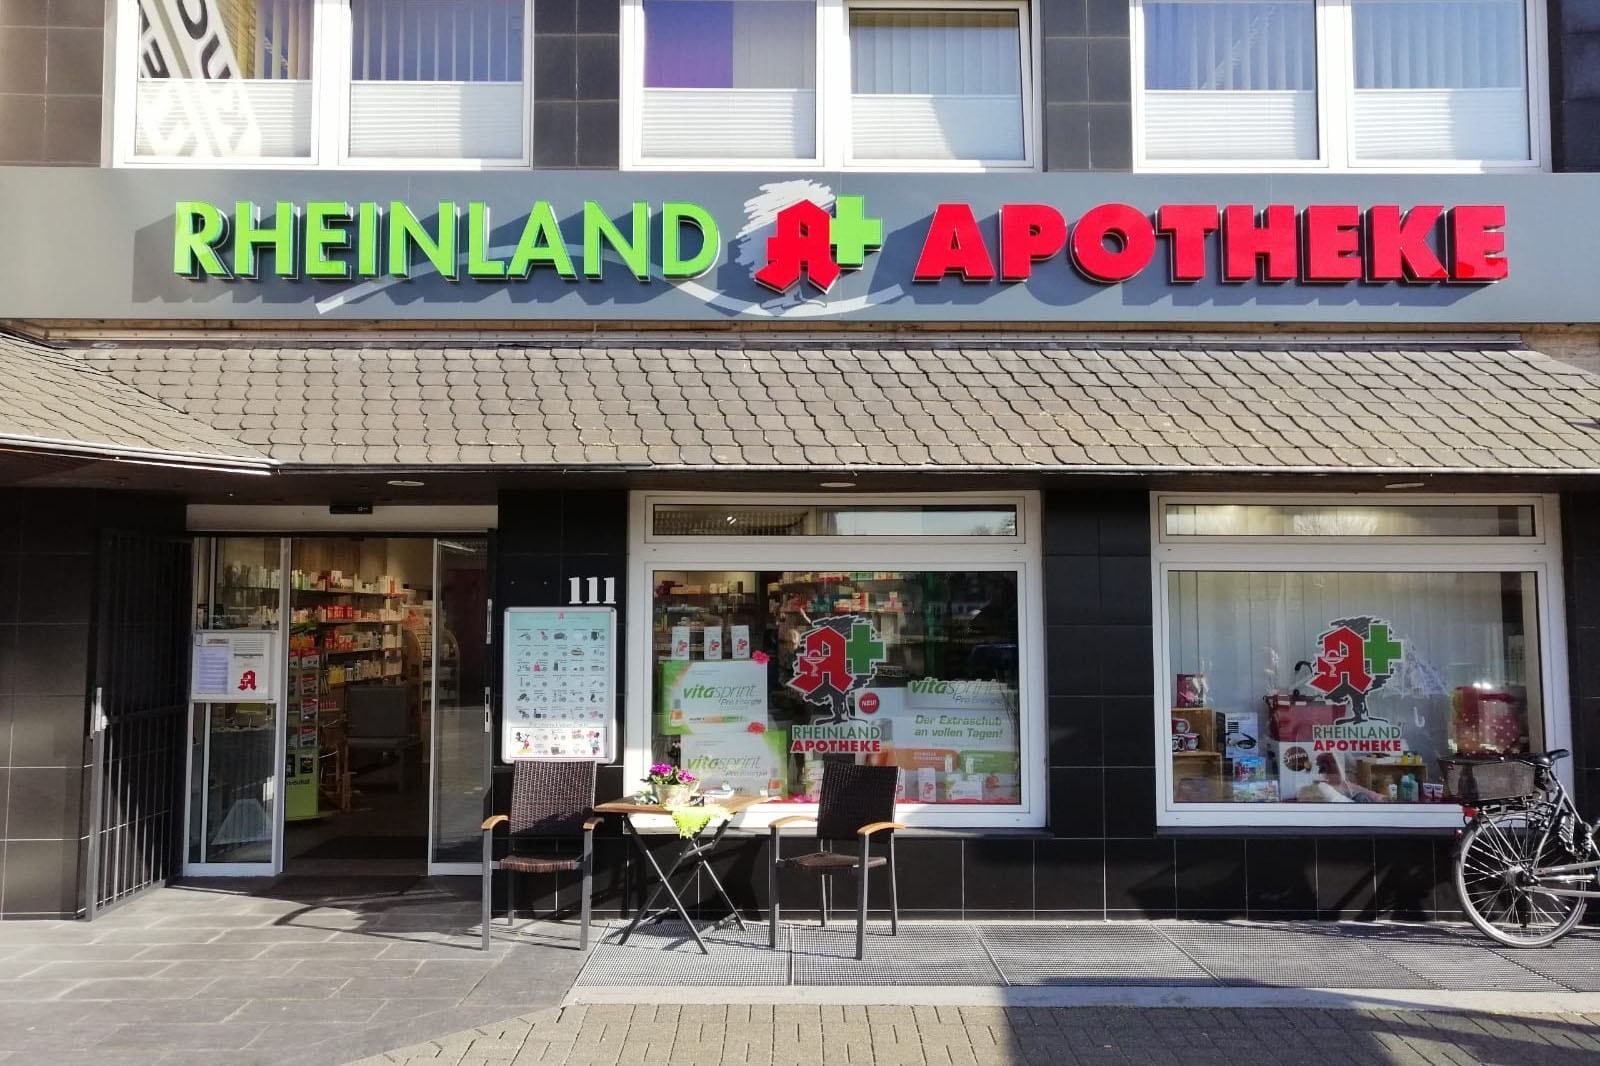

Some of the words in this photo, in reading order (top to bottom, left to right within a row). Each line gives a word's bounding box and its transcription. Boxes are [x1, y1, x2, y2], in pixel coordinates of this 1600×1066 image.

[173, 200, 721, 282] RHEINLAND
[912, 203, 1509, 284] APOTHEKE
[568, 576, 616, 604] 111
[682, 684, 757, 702] vitasprint
[911, 678, 1001, 698] vitasprint
[861, 699, 878, 708] NEU!
[915, 714, 935, 726] Der
[939, 714, 1002, 727] Extraschub
[793, 726, 881, 739] RHEINLAND
[914, 729, 928, 737] an
[931, 727, 963, 738] vollen
[967, 727, 1004, 741] Tagen!
[1313, 726, 1401, 739] RHEINLAND
[791, 740, 881, 753] APOTHEKE
[1312, 739, 1402, 752] APOTHEKE
[687, 754, 762, 771] vitasprint
